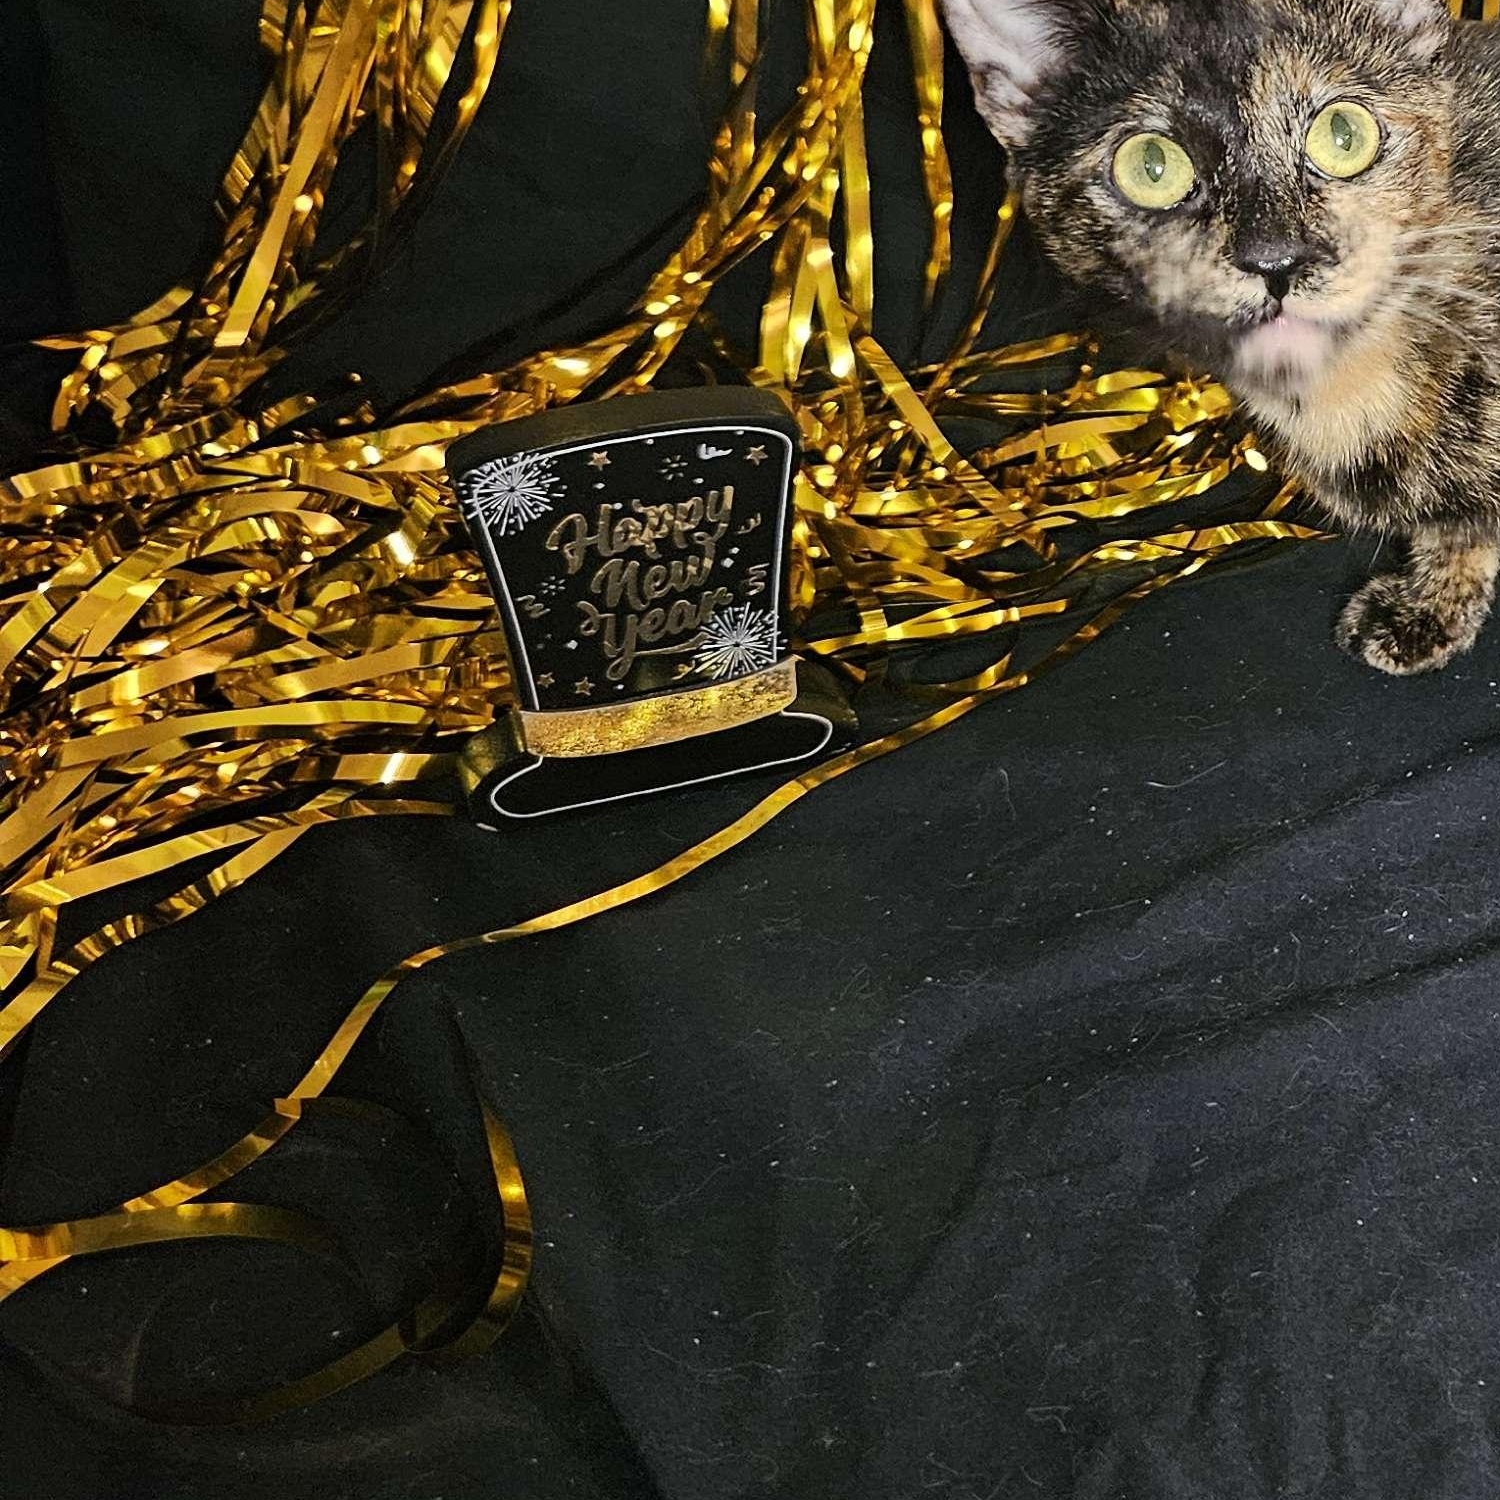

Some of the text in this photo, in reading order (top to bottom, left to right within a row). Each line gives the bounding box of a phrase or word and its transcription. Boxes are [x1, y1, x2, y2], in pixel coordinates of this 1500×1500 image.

[546, 485, 734, 574] Happy
[591, 552, 716, 611] New
[577, 587, 734, 681] Year
